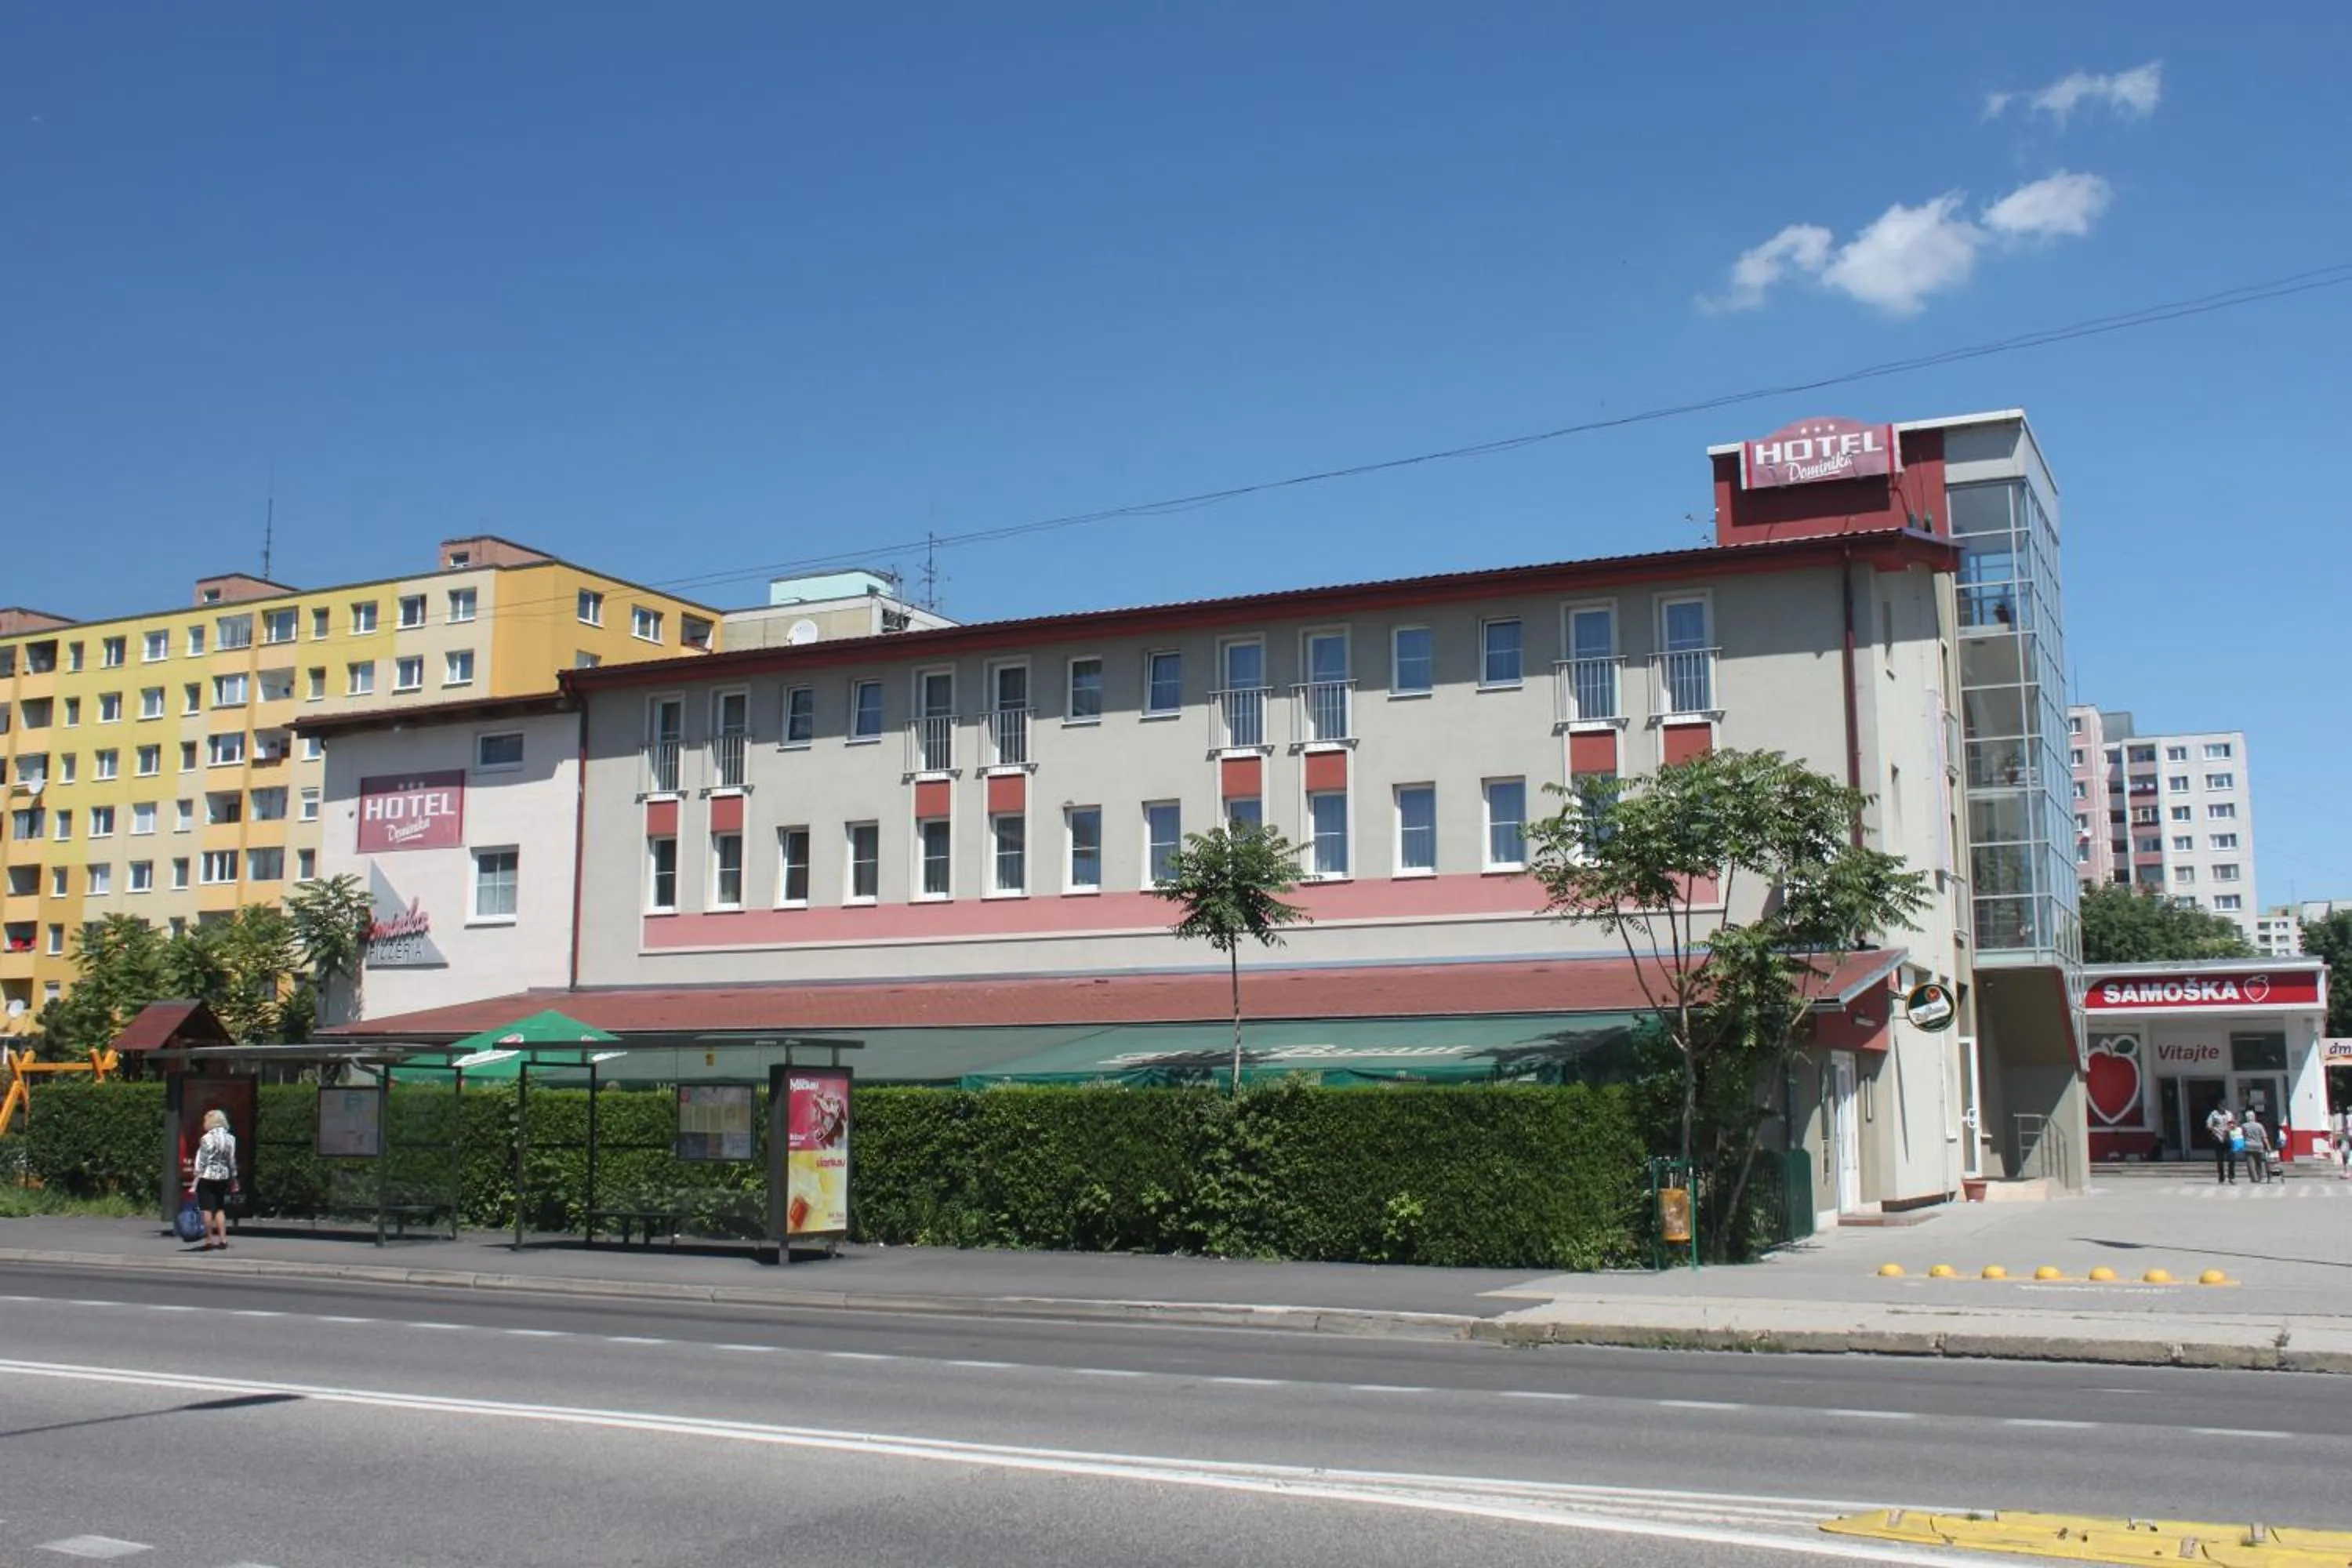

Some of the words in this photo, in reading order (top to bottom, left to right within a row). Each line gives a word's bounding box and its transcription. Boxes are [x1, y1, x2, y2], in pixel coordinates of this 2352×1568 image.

[1755, 430, 1883, 465] HOTEL
[1785, 452, 1854, 482] Dominika
[365, 793, 456, 821] HOTEL
[369, 942, 424, 961] PIZZERIA
[2103, 978, 2240, 1004] SAMOŠKA
[2158, 1044, 2220, 1063] Vitajte
